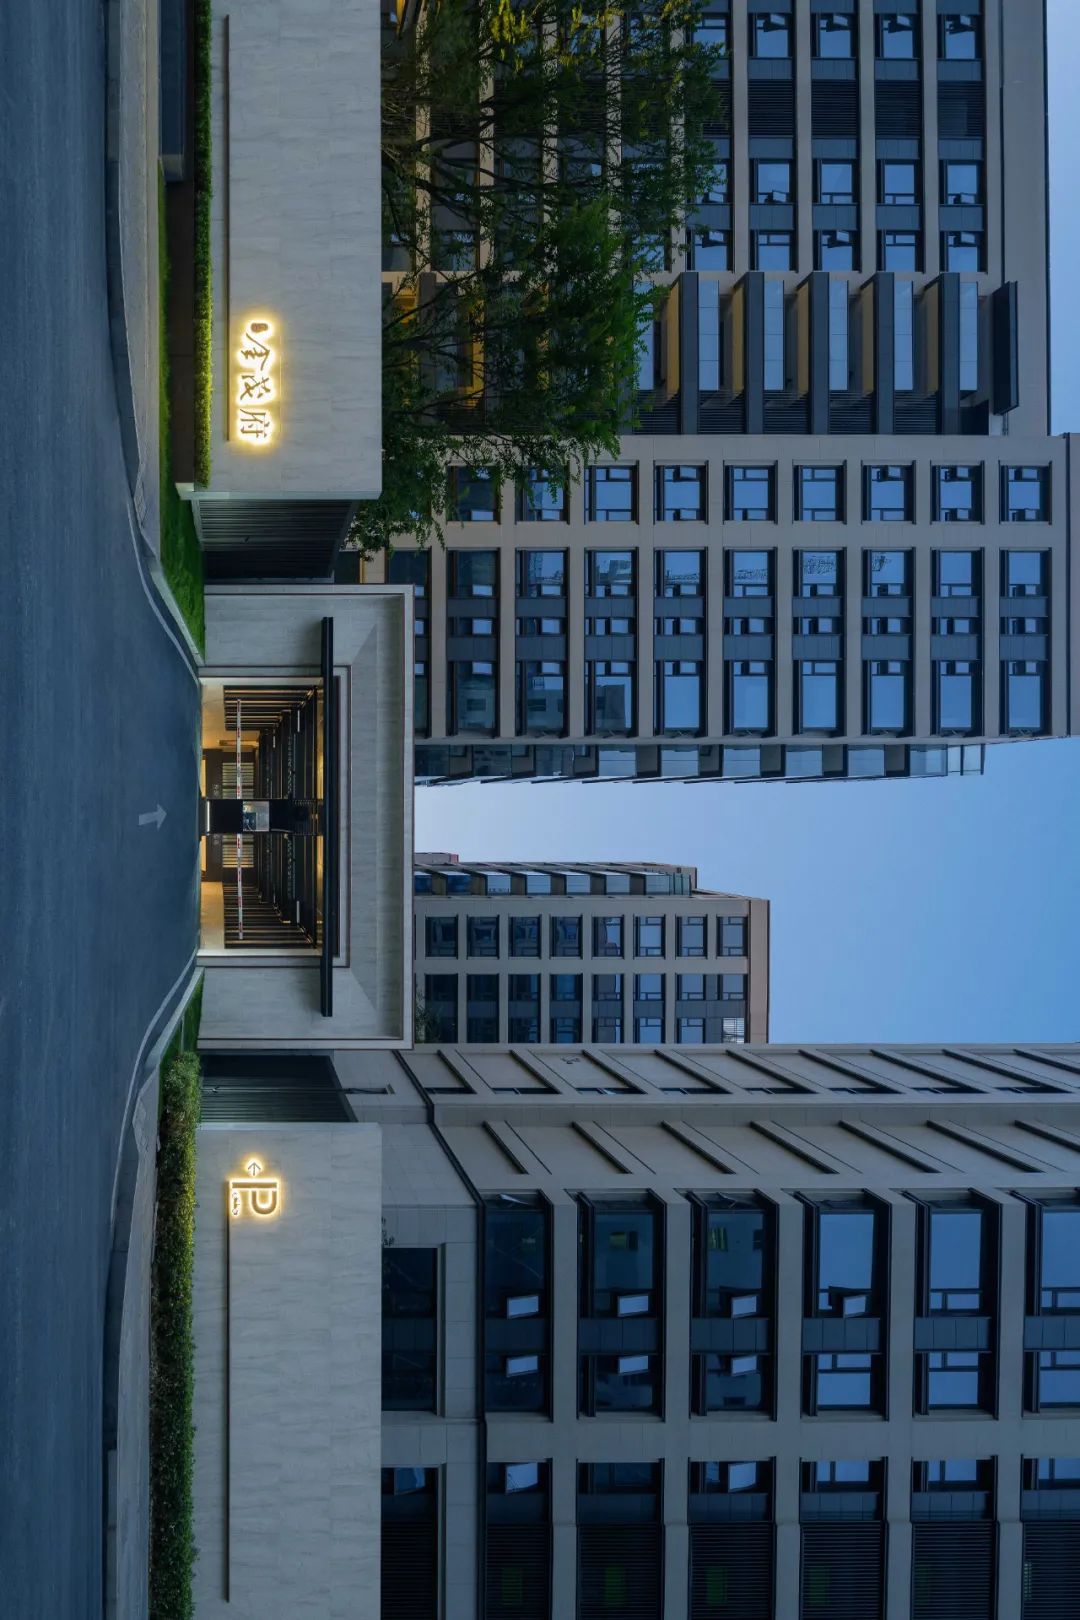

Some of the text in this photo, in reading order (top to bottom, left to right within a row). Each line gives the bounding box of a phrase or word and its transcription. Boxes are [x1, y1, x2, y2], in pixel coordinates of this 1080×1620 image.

[239, 333, 271, 438] 金茂府
[232, 1182, 277, 1215] P
